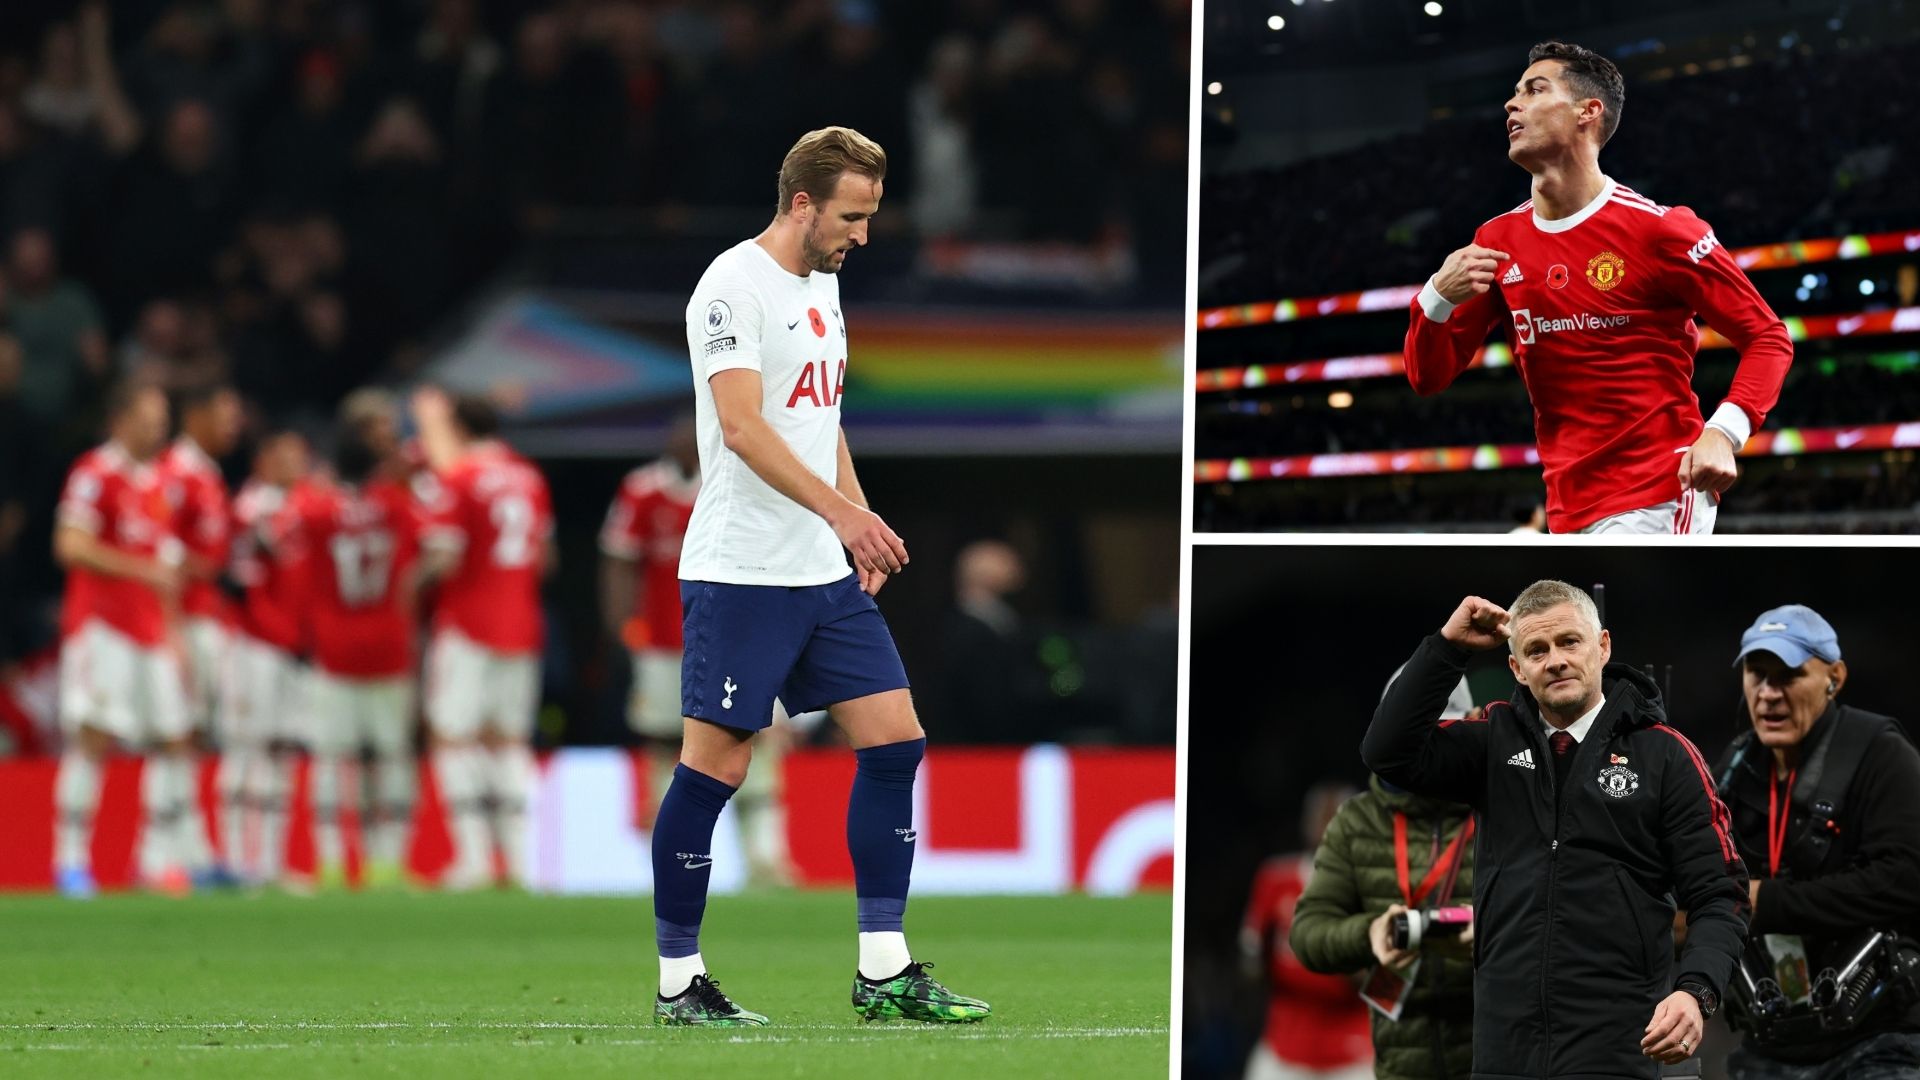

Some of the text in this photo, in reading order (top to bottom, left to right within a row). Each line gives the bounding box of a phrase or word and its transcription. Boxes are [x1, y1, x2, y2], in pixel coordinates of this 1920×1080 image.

[1502, 274, 1523, 285] adidas
[1533, 313, 1631, 333] TeamViewer
[712, 338, 733, 349] room
[786, 358, 845, 409] AIA
[1507, 758, 1536, 770] adidas
